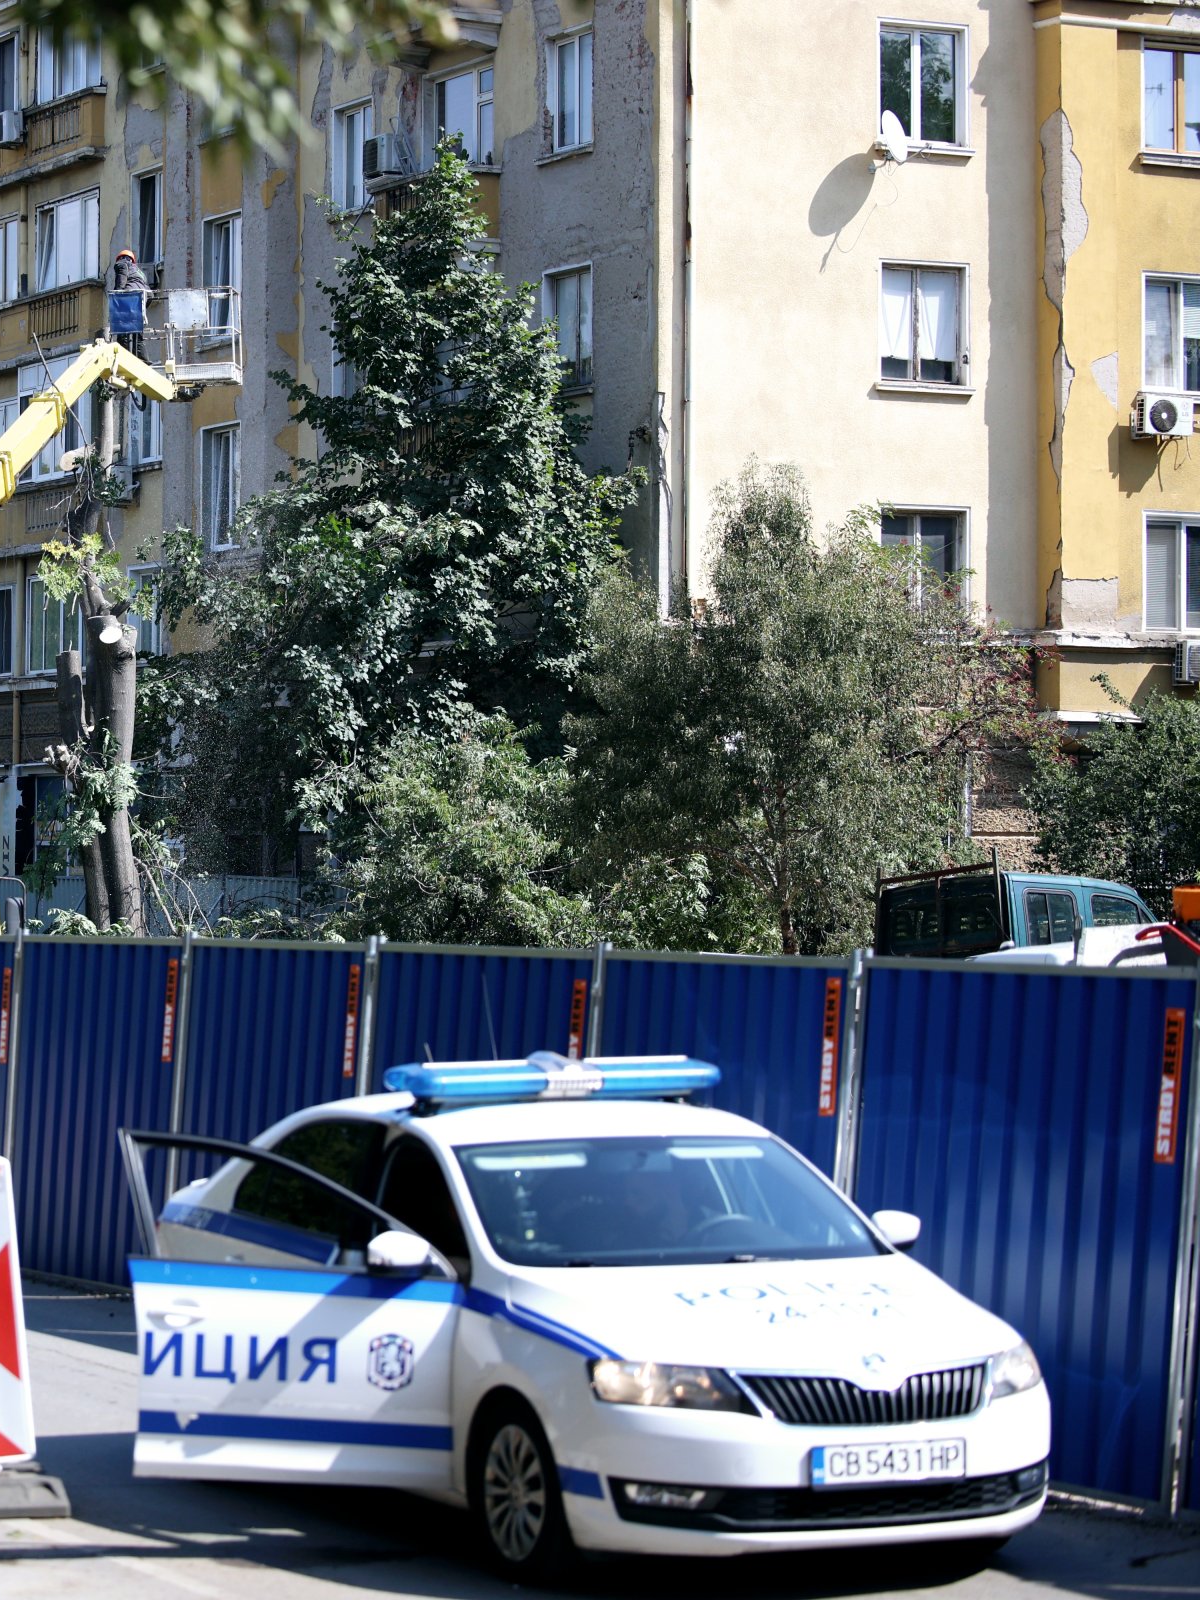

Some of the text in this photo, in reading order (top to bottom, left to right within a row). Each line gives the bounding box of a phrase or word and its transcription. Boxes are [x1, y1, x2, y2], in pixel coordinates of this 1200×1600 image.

[819, 988, 836, 1109] STROYRENT
[1156, 1018, 1178, 1155] STROYRENT
[143, 1331, 337, 1384] ИЦИЯ
[829, 1451, 861, 1478] CB
[866, 1447, 924, 1476] 5431
[929, 1444, 960, 1472] HP
